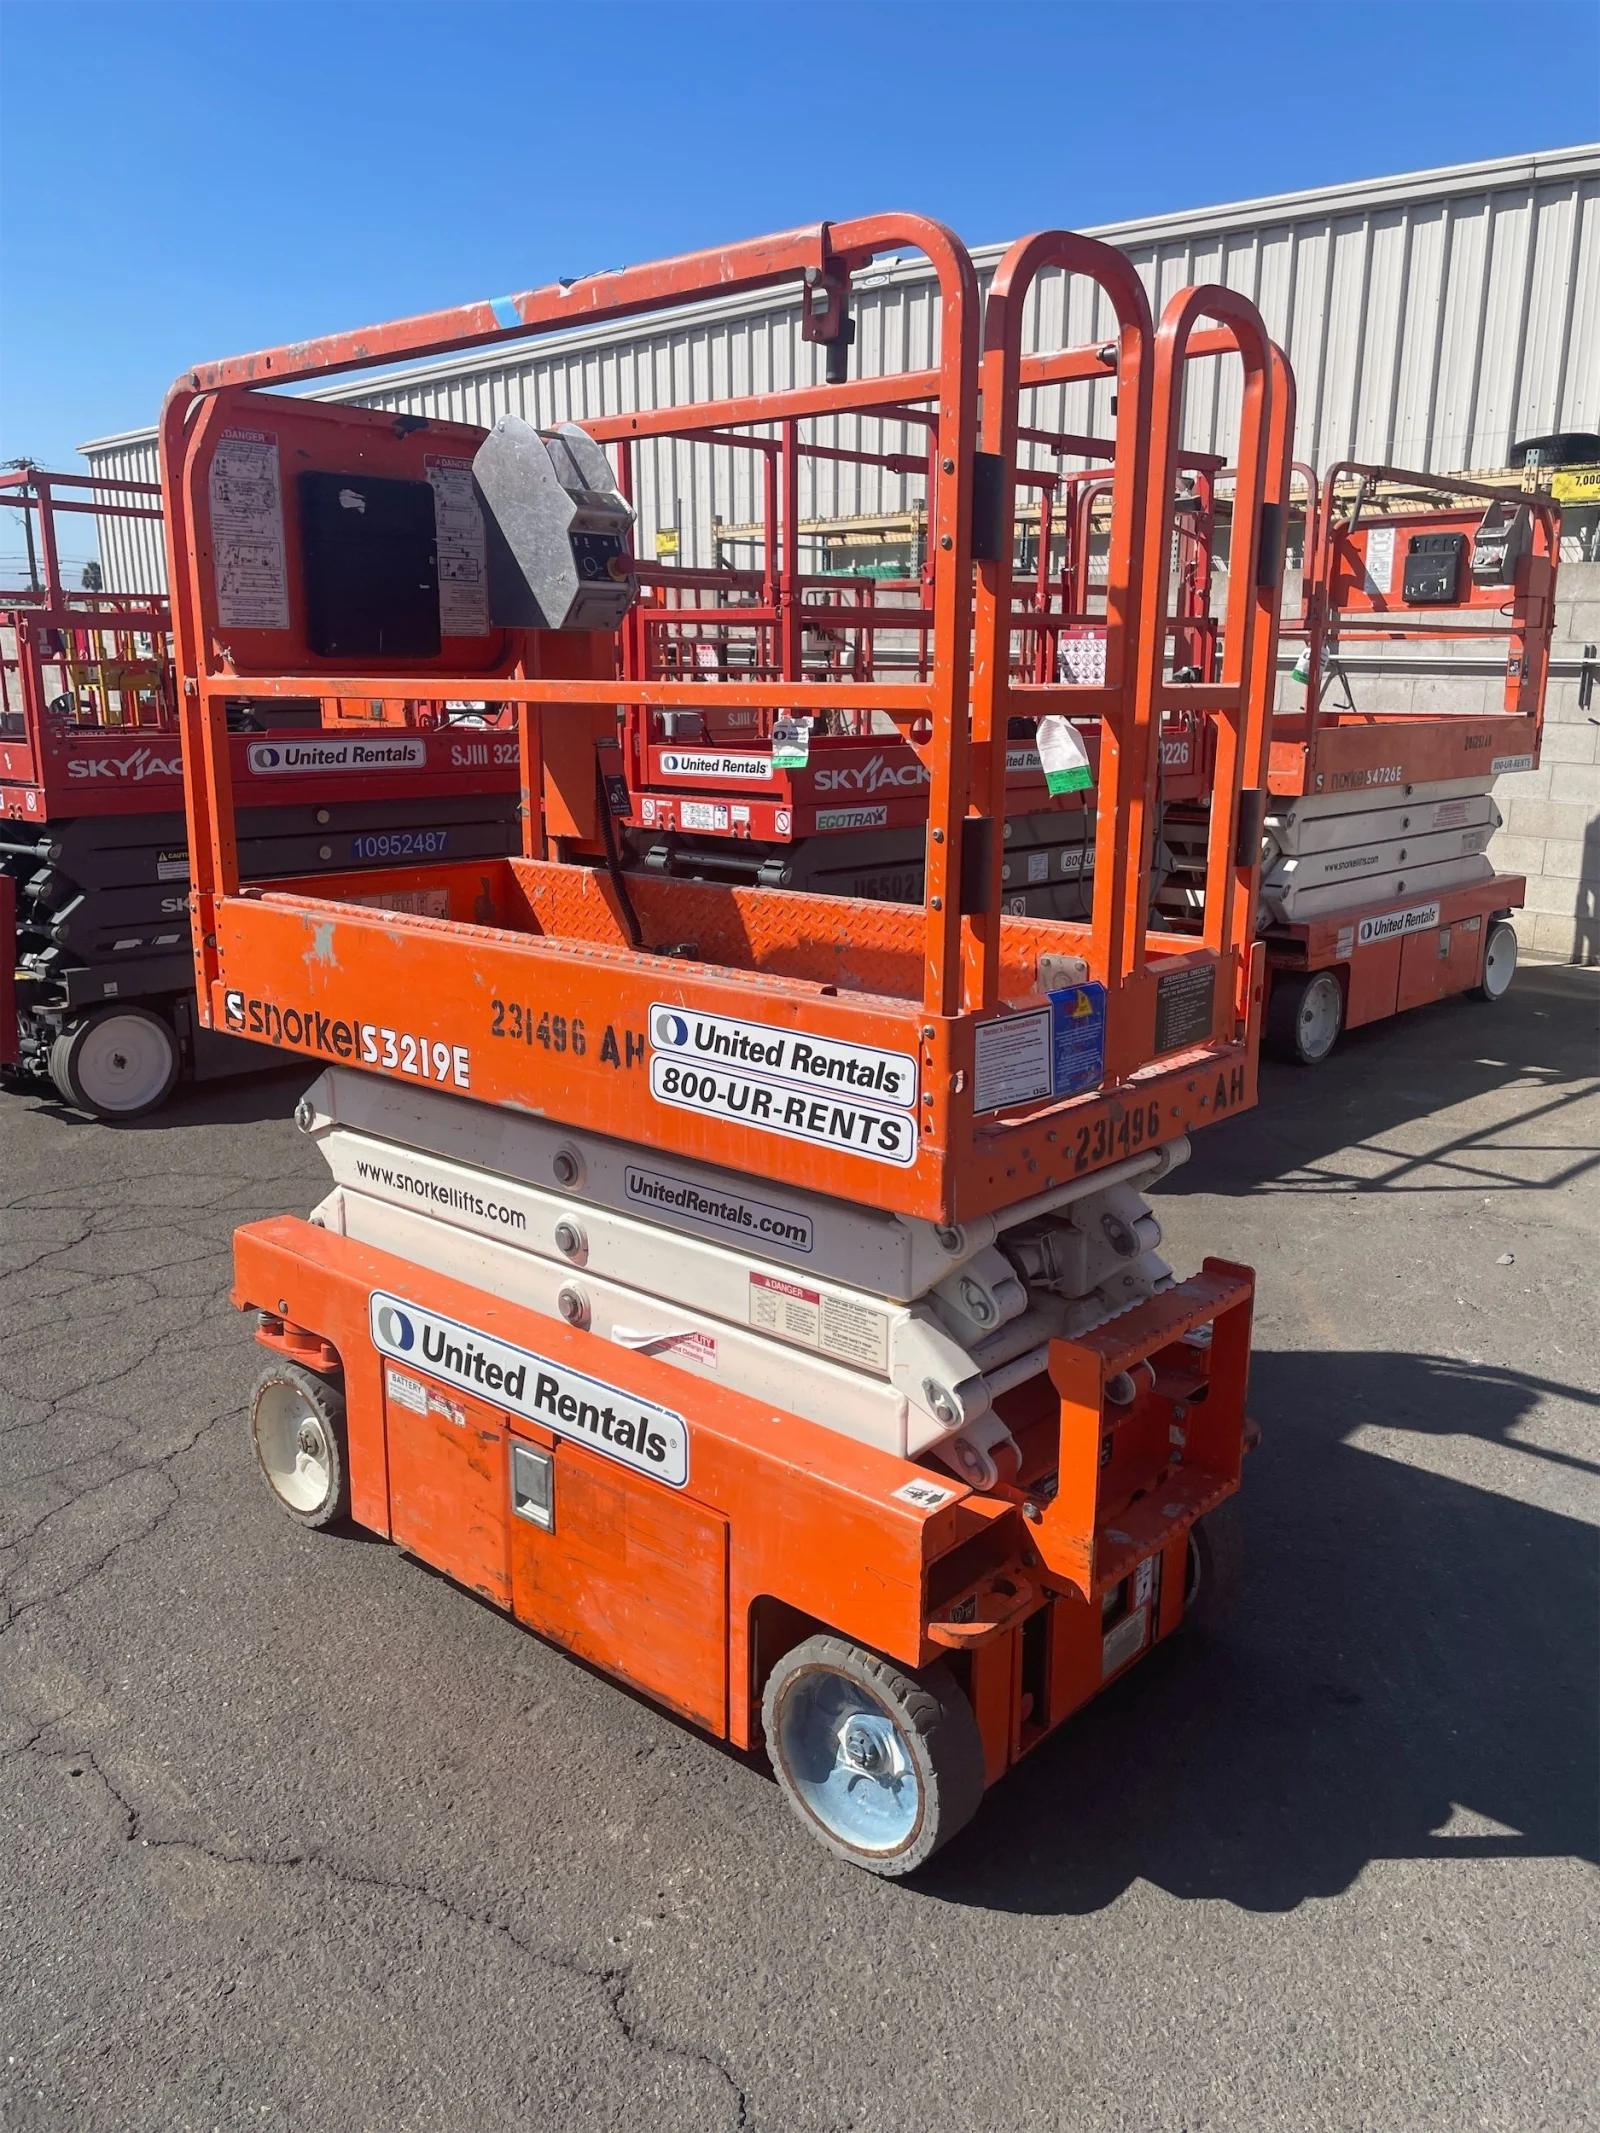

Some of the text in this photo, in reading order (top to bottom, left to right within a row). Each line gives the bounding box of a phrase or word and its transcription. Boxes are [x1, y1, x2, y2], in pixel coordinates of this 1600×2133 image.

[225, 429, 265, 442] DANGER
[67, 748, 183, 780] SKYJAC
[285, 738, 416, 766] United Rentals
[451, 744, 520, 766] SJIII 322
[681, 757, 720, 772] United
[722, 759, 767, 775] Rentals
[1006, 754, 1025, 767] ited
[814, 755, 931, 792] SKYJACK
[1366, 766, 1402, 784] S4726E
[354, 831, 447, 858] 10952487
[1374, 908, 1436, 936] United Rentals
[249, 1000, 361, 1061] snorkel
[361, 1024, 471, 1089] S3219E
[491, 1000, 645, 1070] 231496 AH
[694, 1022, 901, 1094] United Rentals
[662, 1067, 902, 1151] 800-UR-RENTS
[1074, 1064, 1245, 1172] 231496 AH
[356, 1160, 527, 1230] www.snorkellifts.com
[630, 1174, 807, 1244] UnitedRentals.com
[771, 1281, 803, 1298] DANGER
[391, 1373, 421, 1393] BATTERY
[422, 1325, 526, 1400] United
[534, 1372, 668, 1463] Rentals
